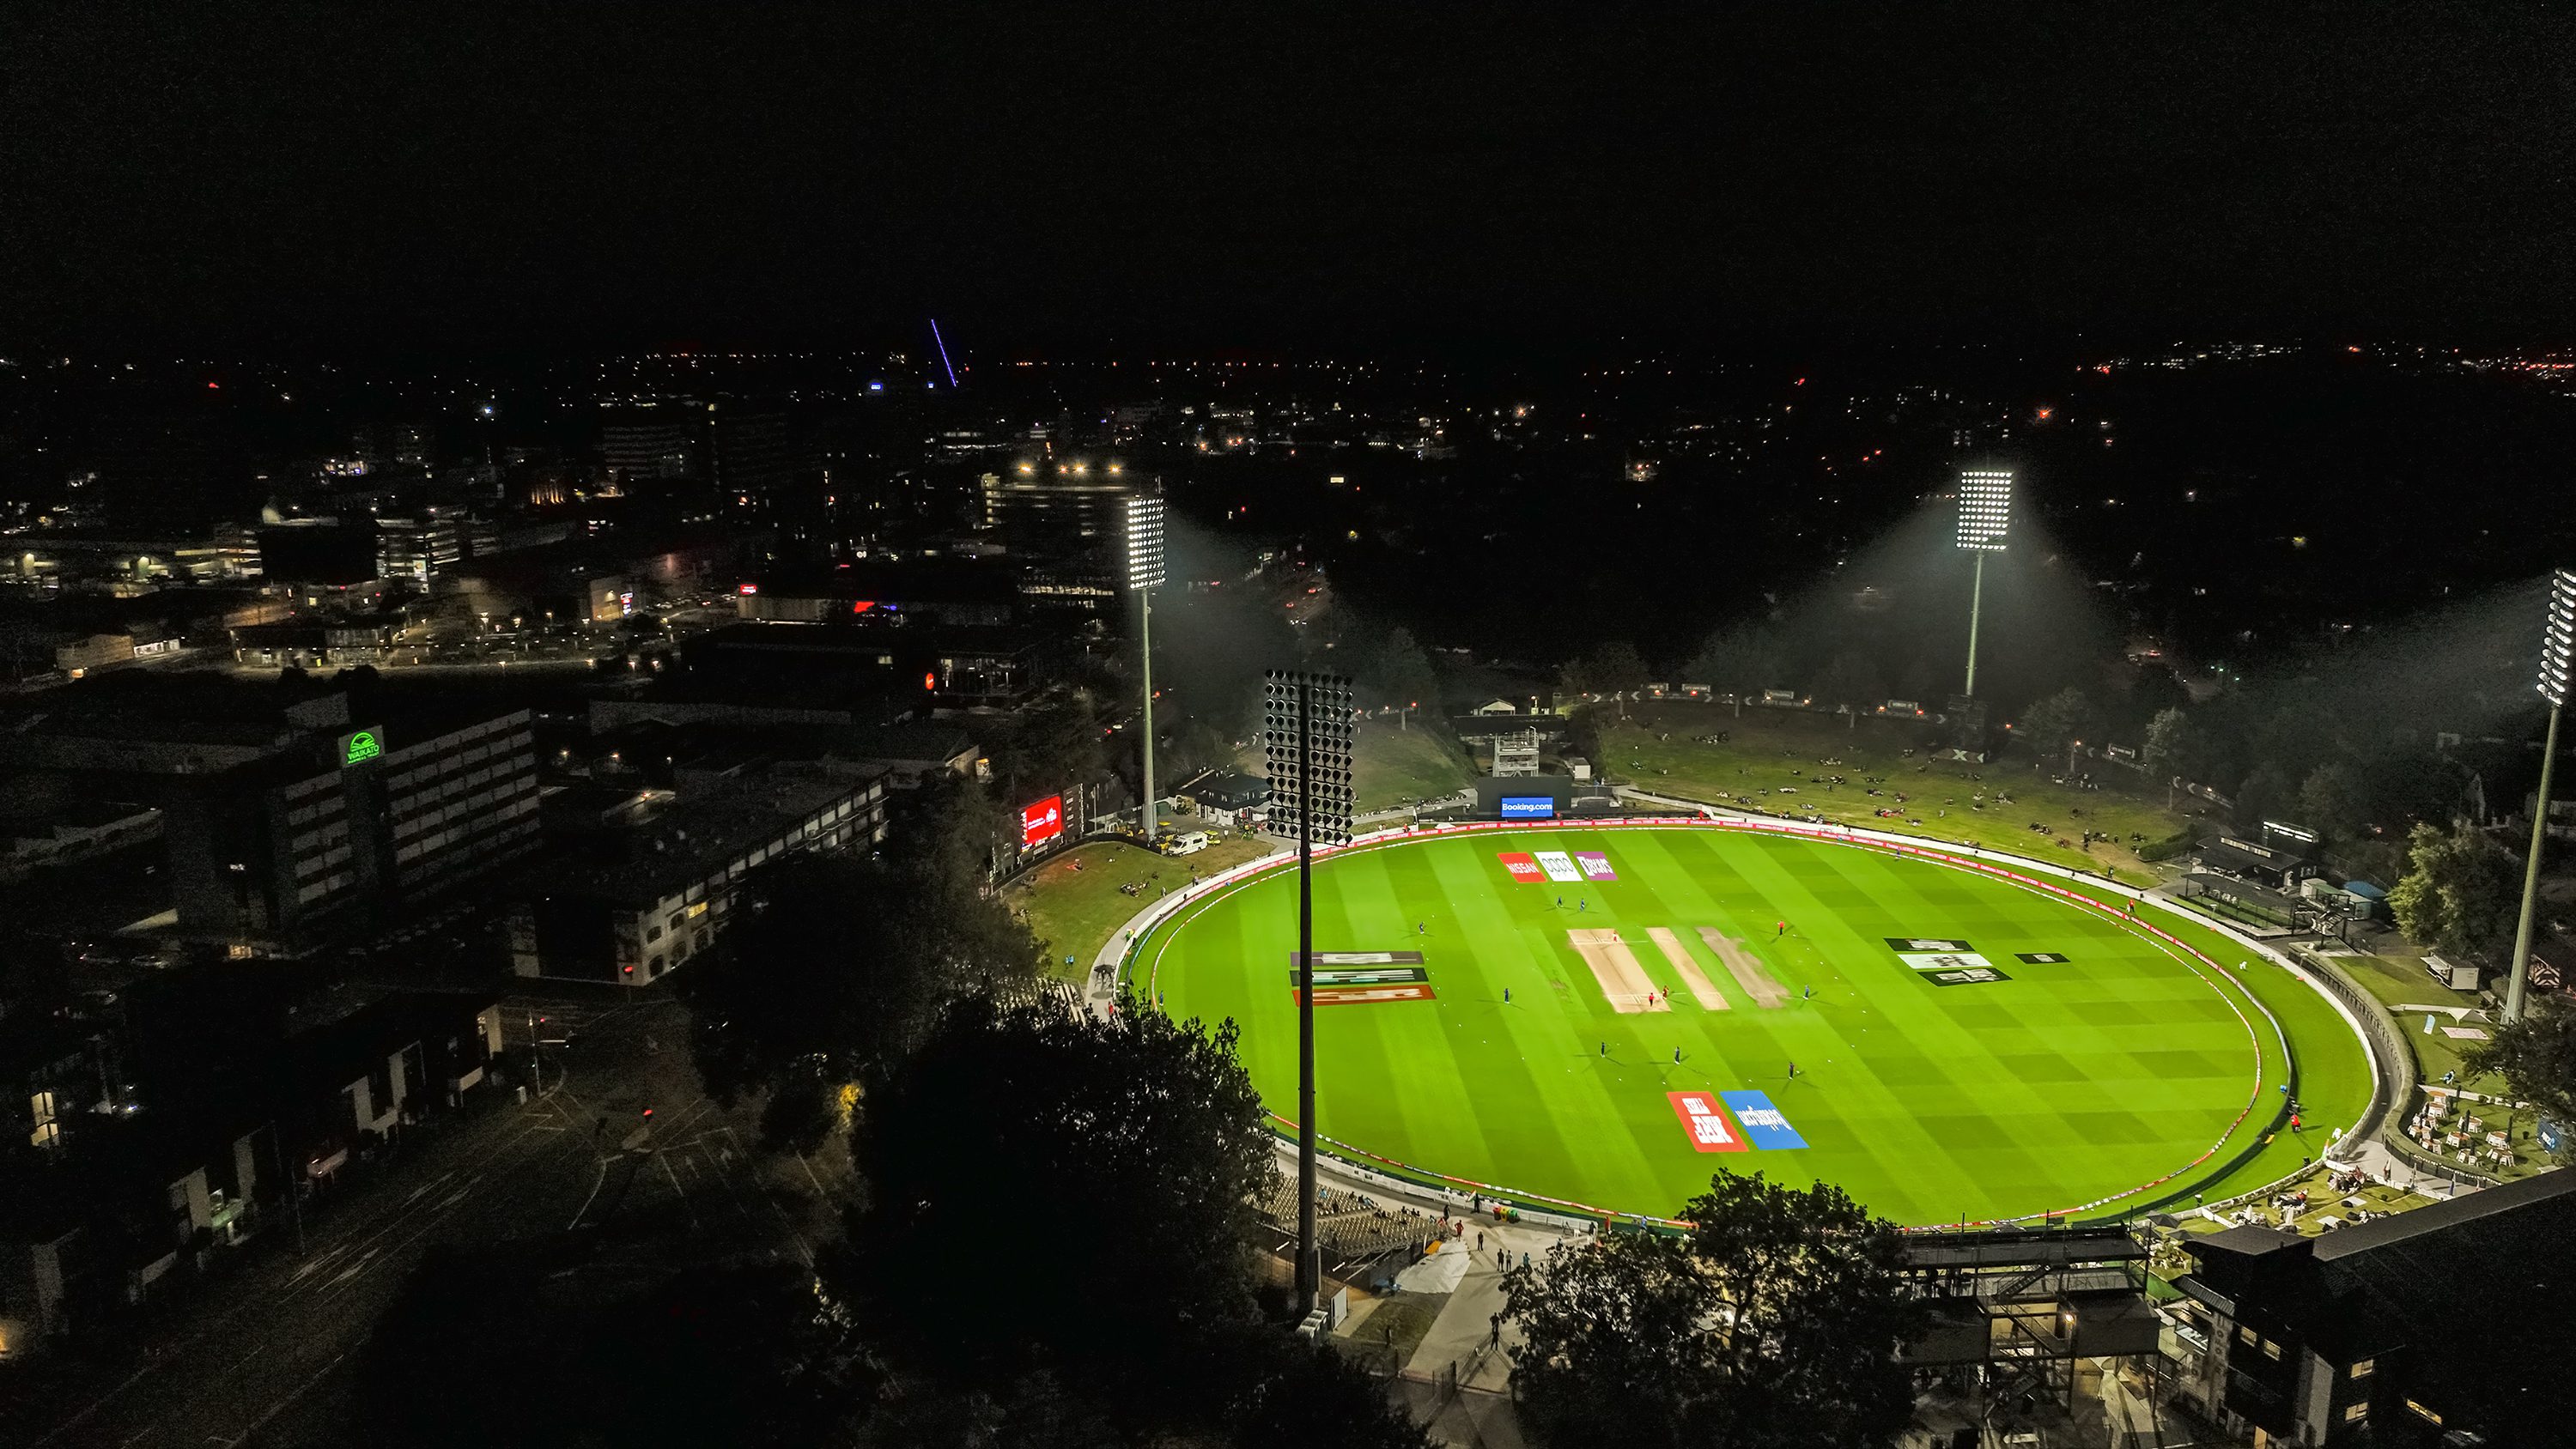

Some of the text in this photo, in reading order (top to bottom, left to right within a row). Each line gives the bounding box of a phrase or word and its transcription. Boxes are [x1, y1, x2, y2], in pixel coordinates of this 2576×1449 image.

[348, 745, 379, 760] WAIKATO
[1502, 803, 1552, 812] Booking.com
[1505, 862, 1540, 874] NISSAN
[1735, 1105, 1793, 1132] Booking.com
